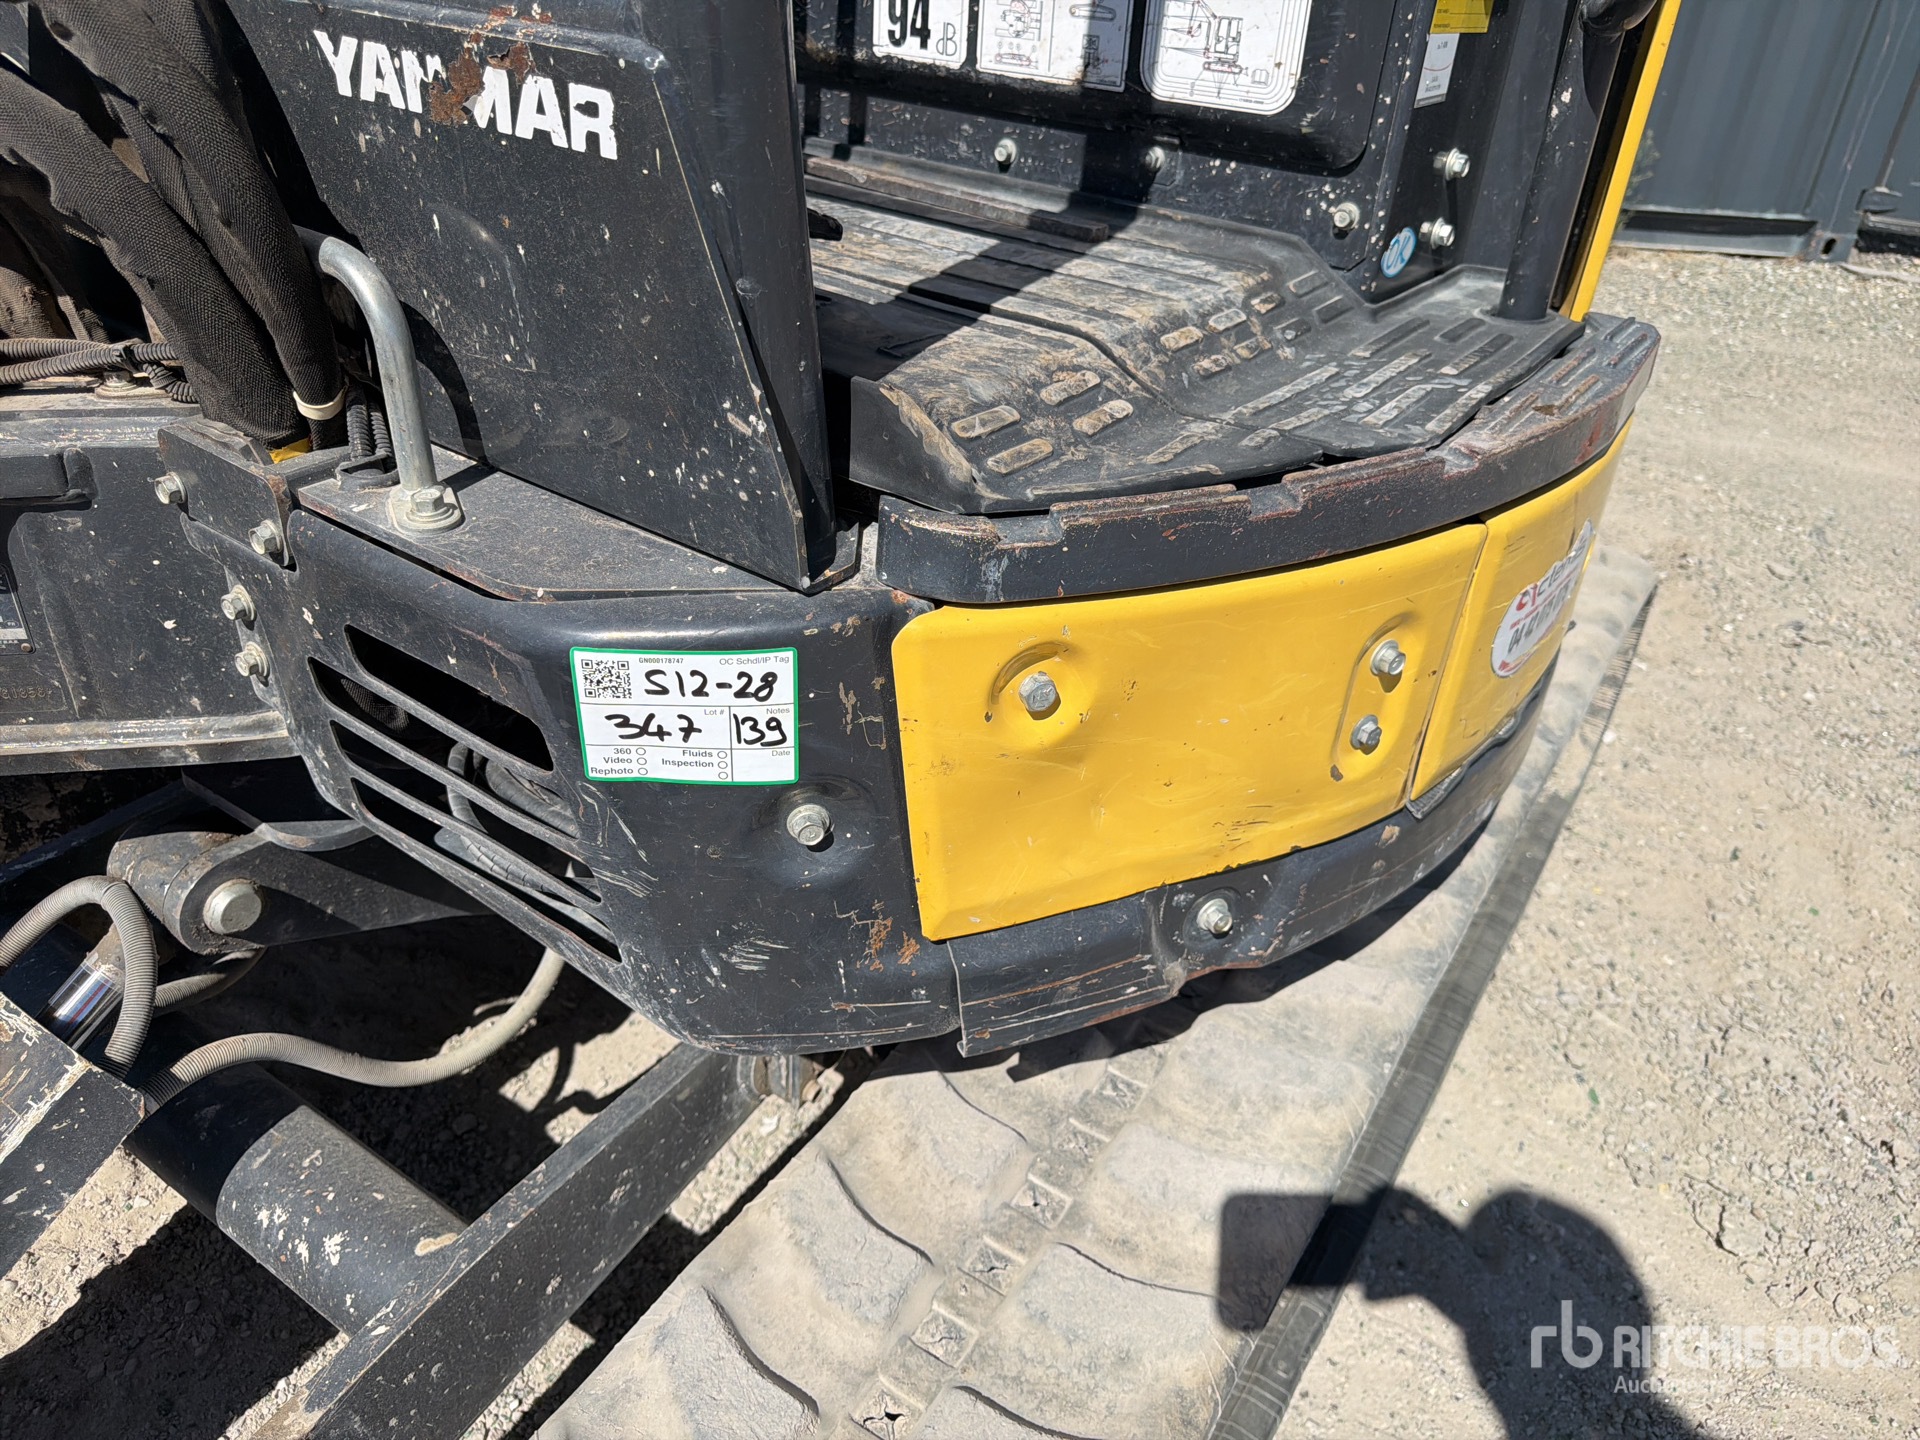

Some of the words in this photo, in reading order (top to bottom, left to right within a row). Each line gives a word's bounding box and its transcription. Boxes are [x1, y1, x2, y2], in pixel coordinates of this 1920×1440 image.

[719, 658, 734, 666] OC
[774, 655, 790, 664] Tag
[644, 669, 778, 702] S12-28
[703, 708, 718, 716] Lot
[717, 708, 725, 716] #
[766, 706, 790, 715] Notes
[604, 712, 702, 743] 347
[732, 713, 787, 747] 139
[613, 747, 632, 755] 360
[682, 749, 713, 758] Fluids
[771, 749, 790, 757] Date
[661, 758, 714, 768] Inspection
[590, 767, 634, 775] Rephoto
